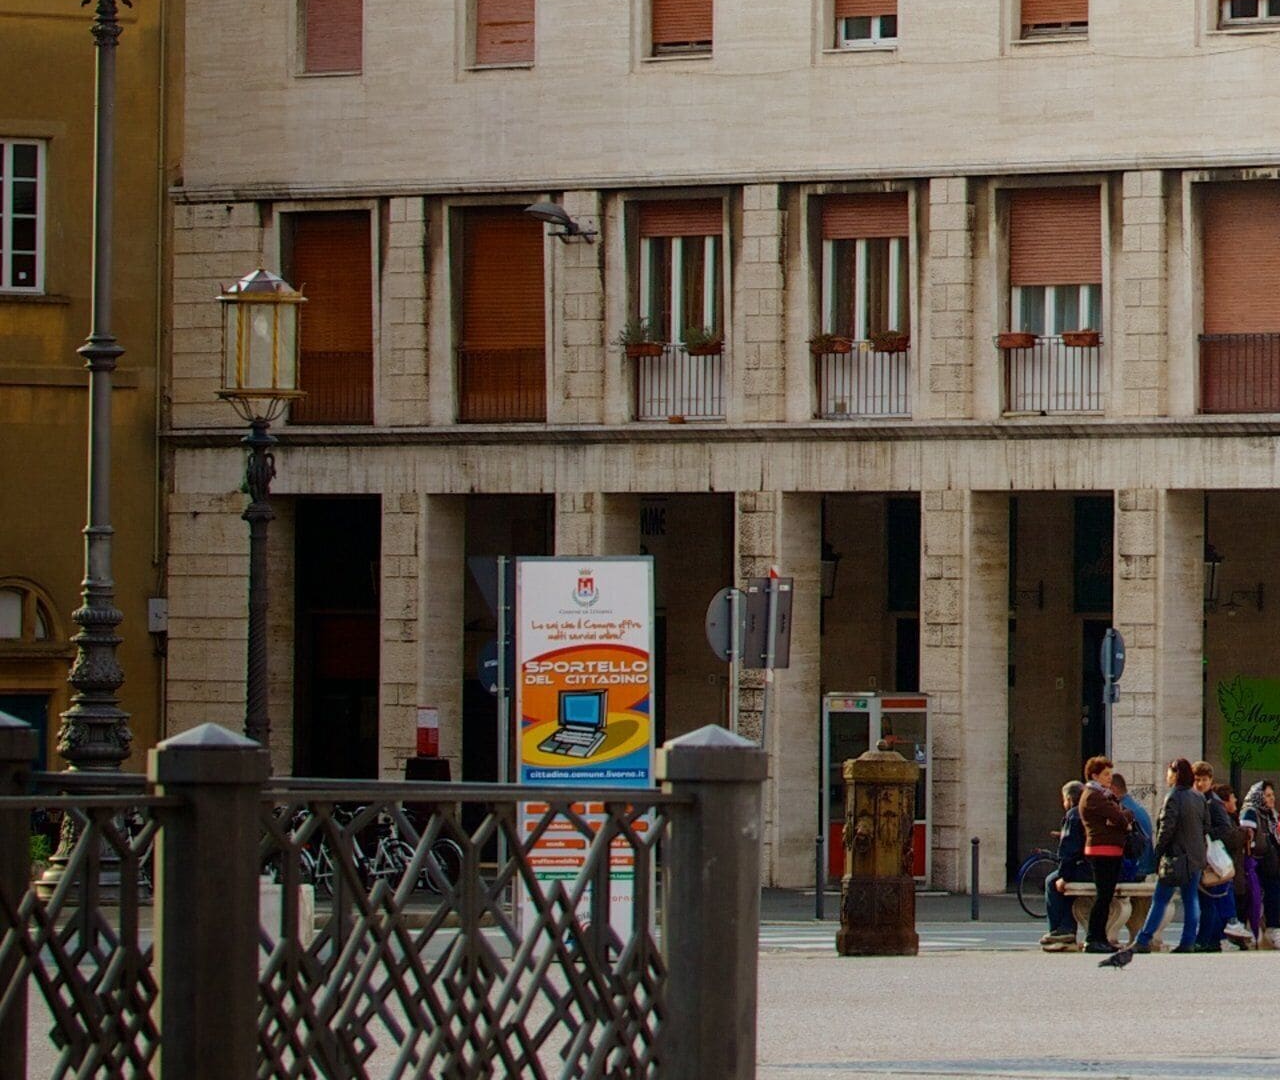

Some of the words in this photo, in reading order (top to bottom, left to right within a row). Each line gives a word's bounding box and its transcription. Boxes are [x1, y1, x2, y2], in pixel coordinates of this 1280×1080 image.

[531, 620, 543, 629] Lo
[583, 620, 616, 629] Comune
[525, 661, 648, 673] SPORTELLO
[525, 675, 555, 685] DEL
[564, 674, 648, 684] CITTADINO
[530, 769, 646, 779] cittadino.comune.livorno.it
